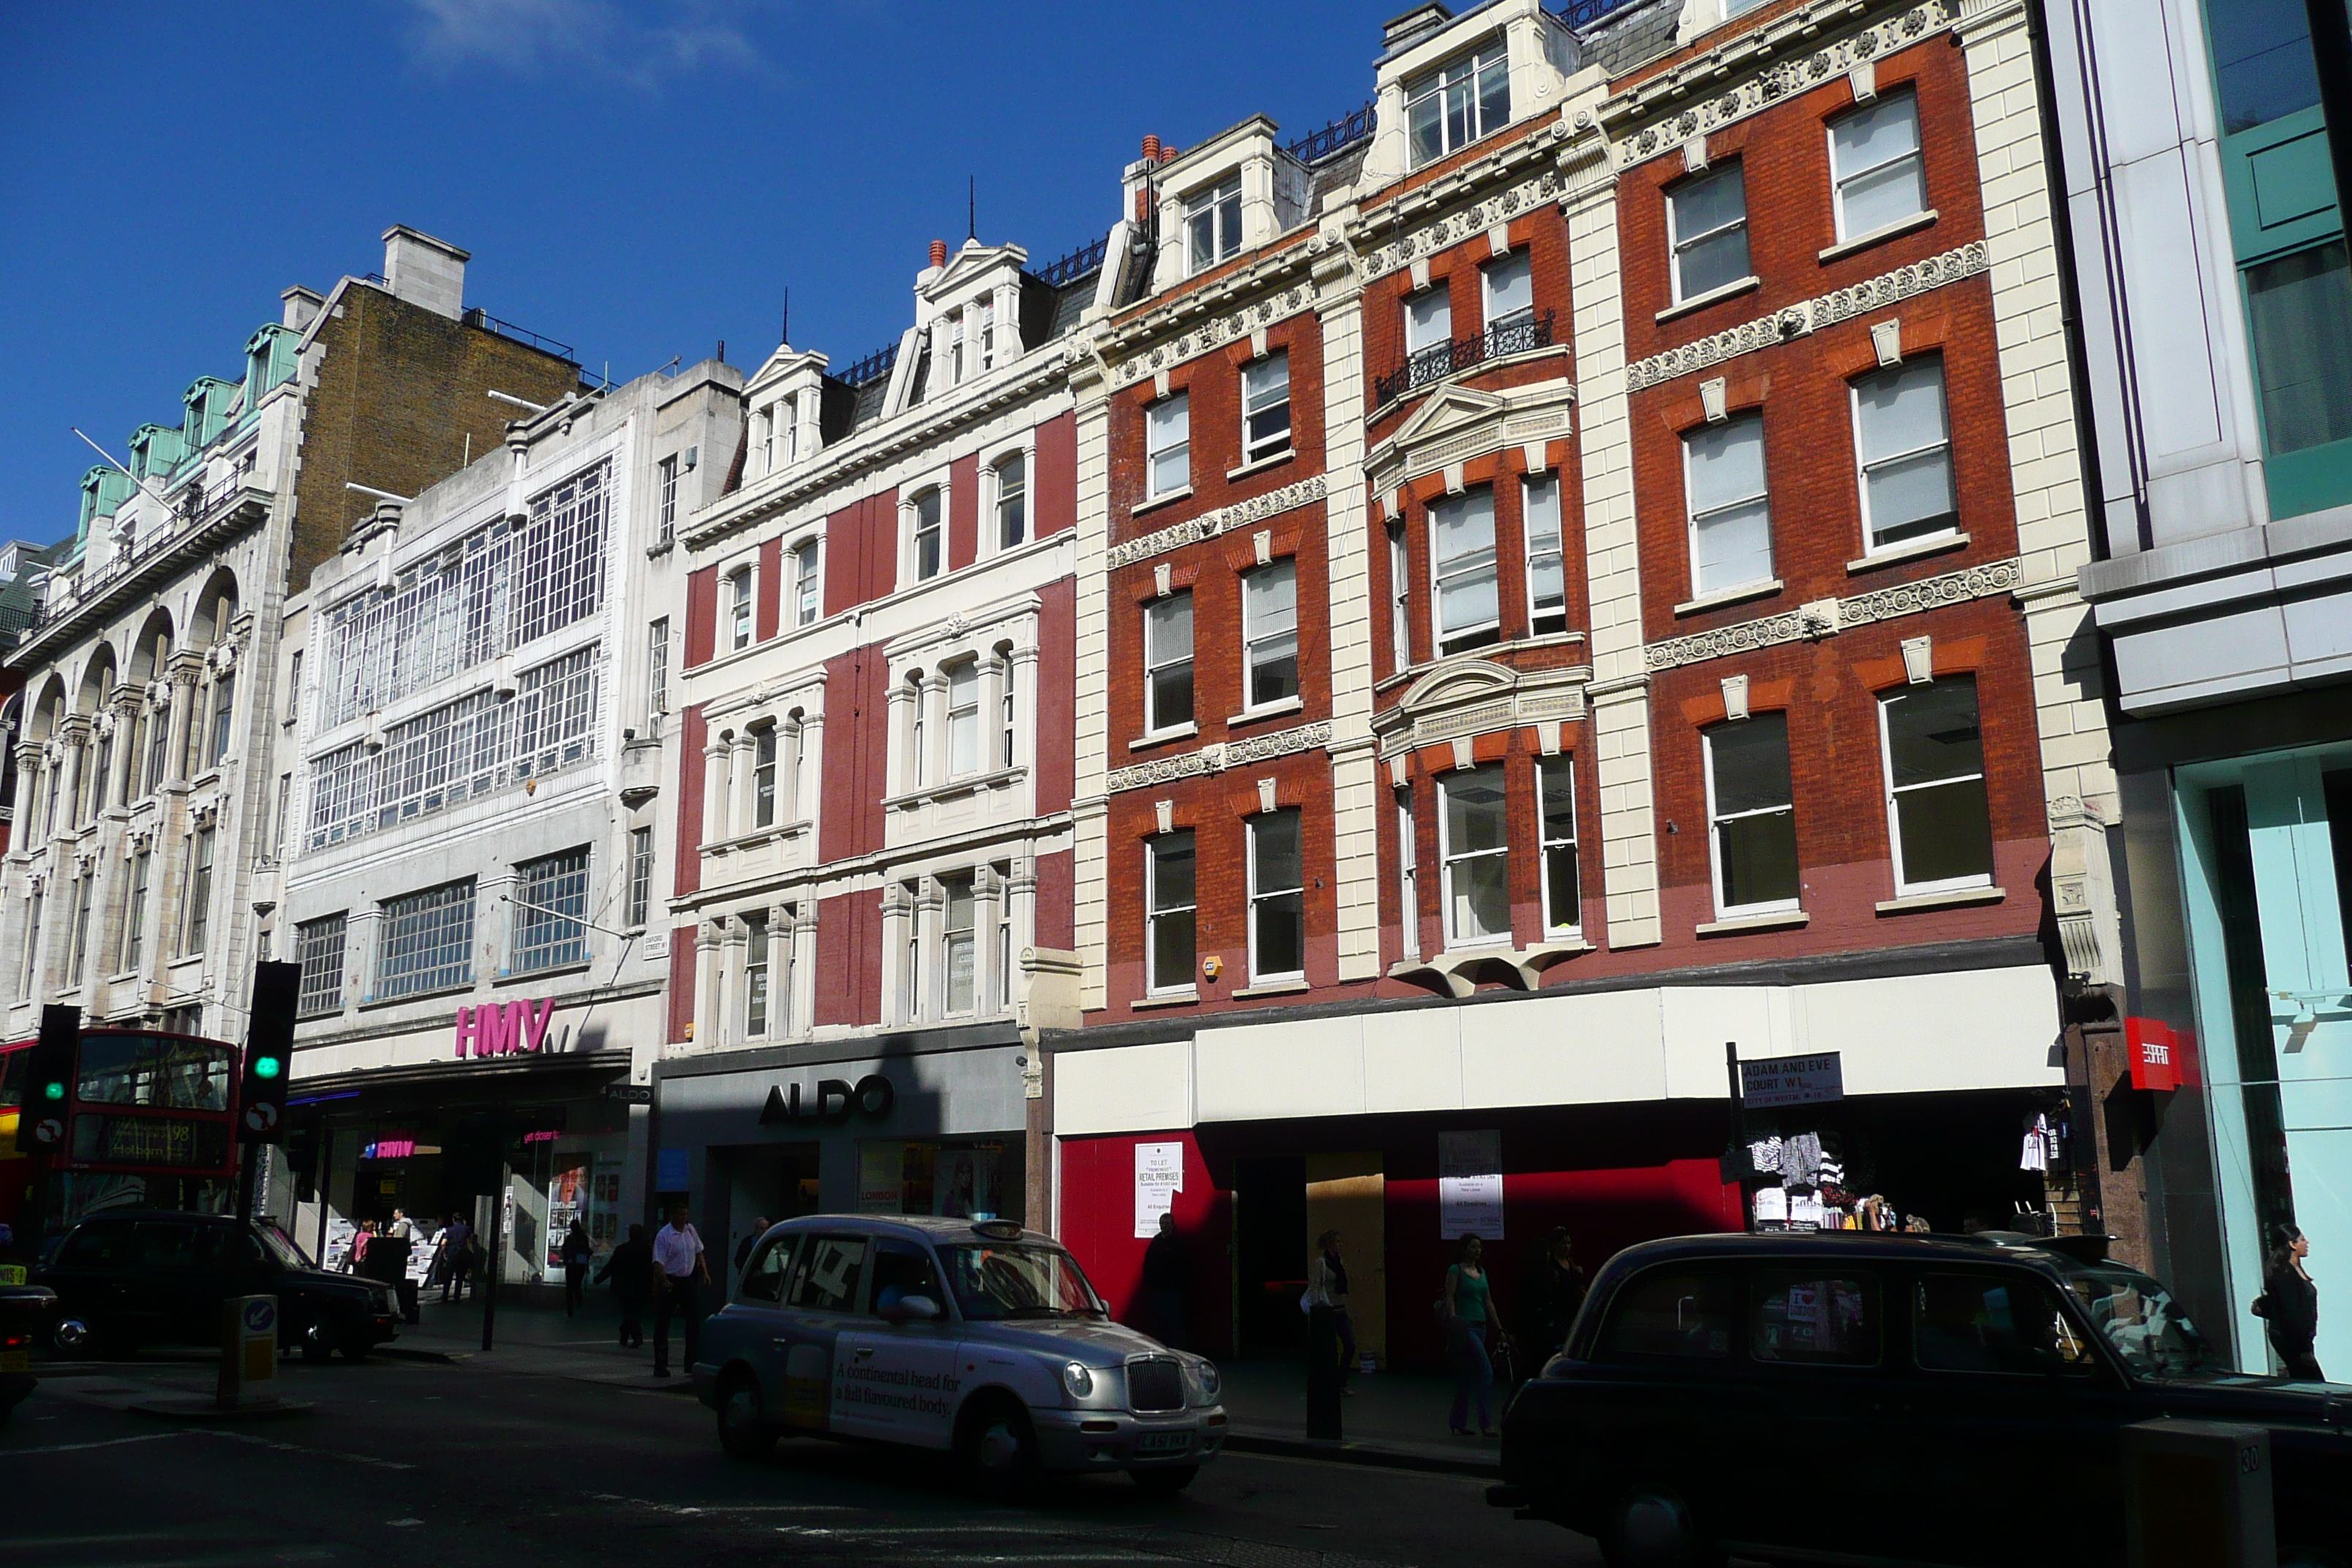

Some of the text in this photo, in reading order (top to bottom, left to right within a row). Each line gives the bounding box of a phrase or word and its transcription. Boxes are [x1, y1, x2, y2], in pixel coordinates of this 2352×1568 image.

[645, 943, 660, 951] STREET
[455, 998, 556, 1058] HMV
[1744, 1059, 1831, 1077] ADAM AND EVE
[1746, 1078, 1779, 1091] COURT
[610, 1090, 650, 1100] ALDO
[758, 1074, 895, 1125] ALDO
[173, 1125, 189, 1141] 98
[1139, 1172, 1179, 1182] RETAIL PREMISES
[862, 1191, 897, 1201] LONDON
[837, 1363, 960, 1392] A continental head for
[836, 1387, 842, 1400] a
[844, 1384, 861, 1402] full
[864, 1387, 916, 1410] flavoured
[919, 1397, 951, 1418] body.
[2241, 1445, 2258, 1474] 30
